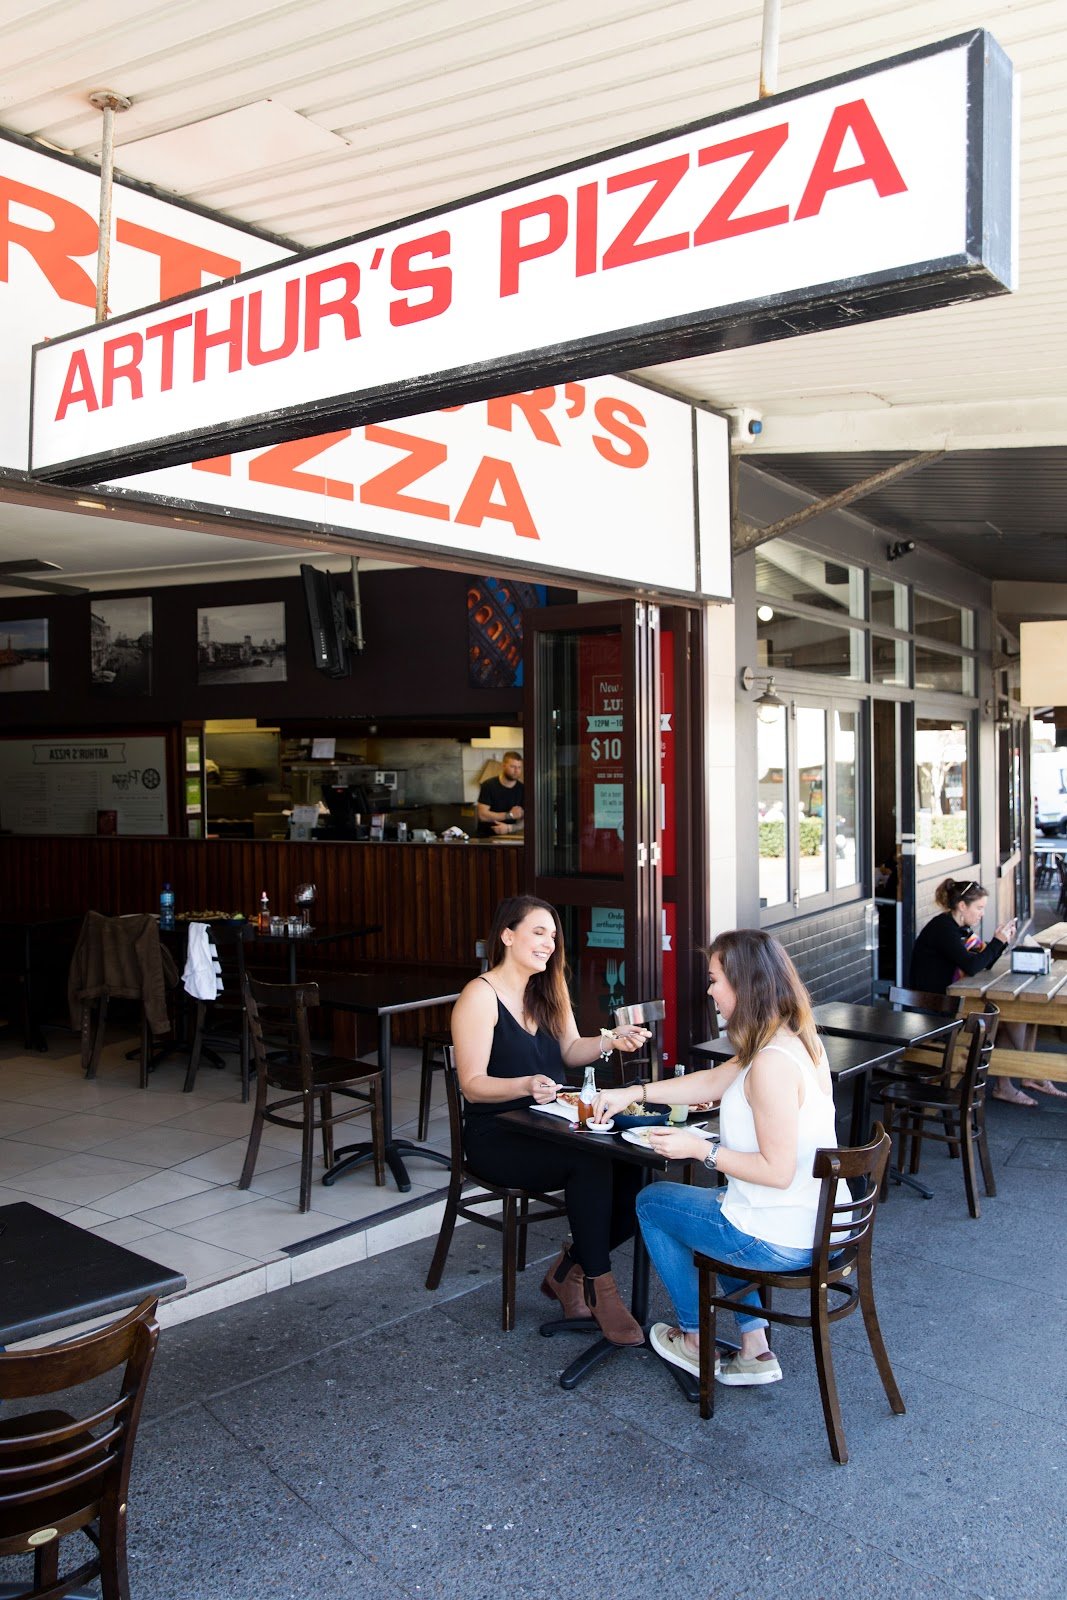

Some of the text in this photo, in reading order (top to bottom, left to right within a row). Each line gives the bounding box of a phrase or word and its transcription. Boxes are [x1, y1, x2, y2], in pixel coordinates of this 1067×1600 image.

[54, 98, 909, 422] ARTHUR'S PIZZA
[603, 699, 623, 711] LU
[591, 737, 621, 761] $10
